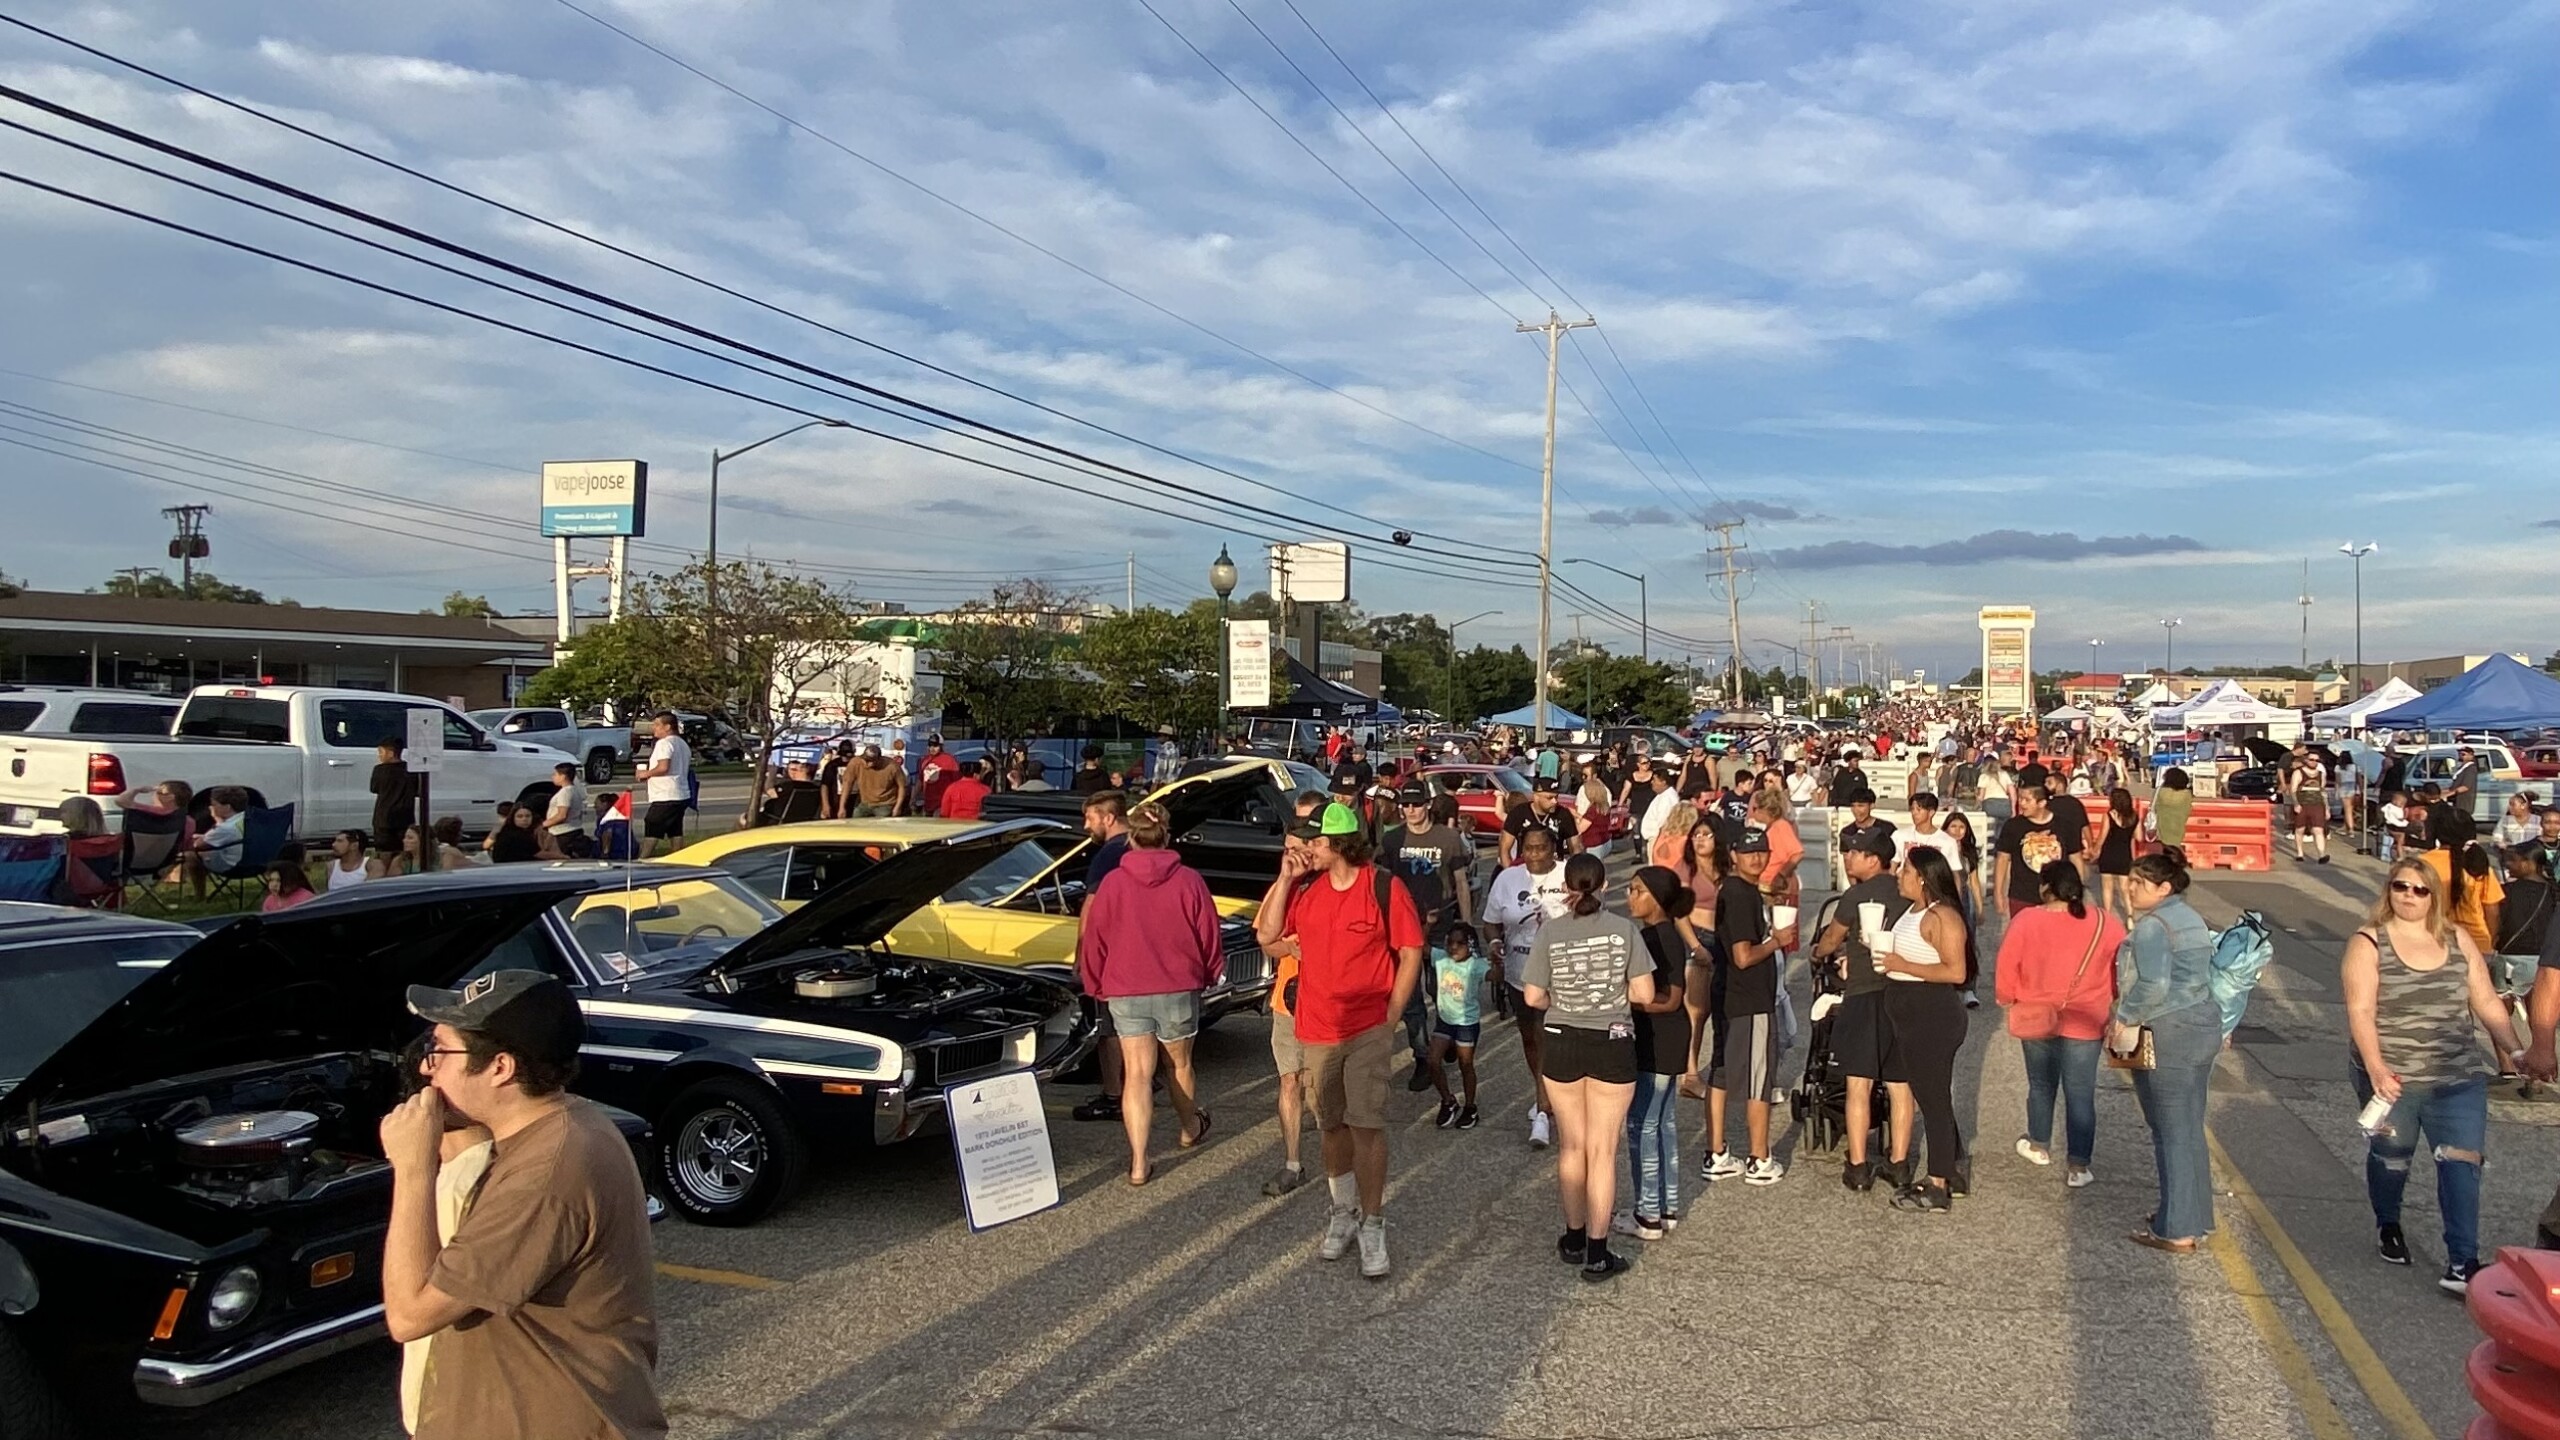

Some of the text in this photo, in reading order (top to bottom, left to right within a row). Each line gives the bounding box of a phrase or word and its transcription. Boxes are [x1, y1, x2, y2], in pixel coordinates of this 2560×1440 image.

[553, 469, 626, 496] vapejoose
[965, 1128, 1043, 1154] MARK DONOHUE EDITION
[990, 1125, 1016, 1138] JAVELIN
[664, 1144, 712, 1214] BFGoodrich
